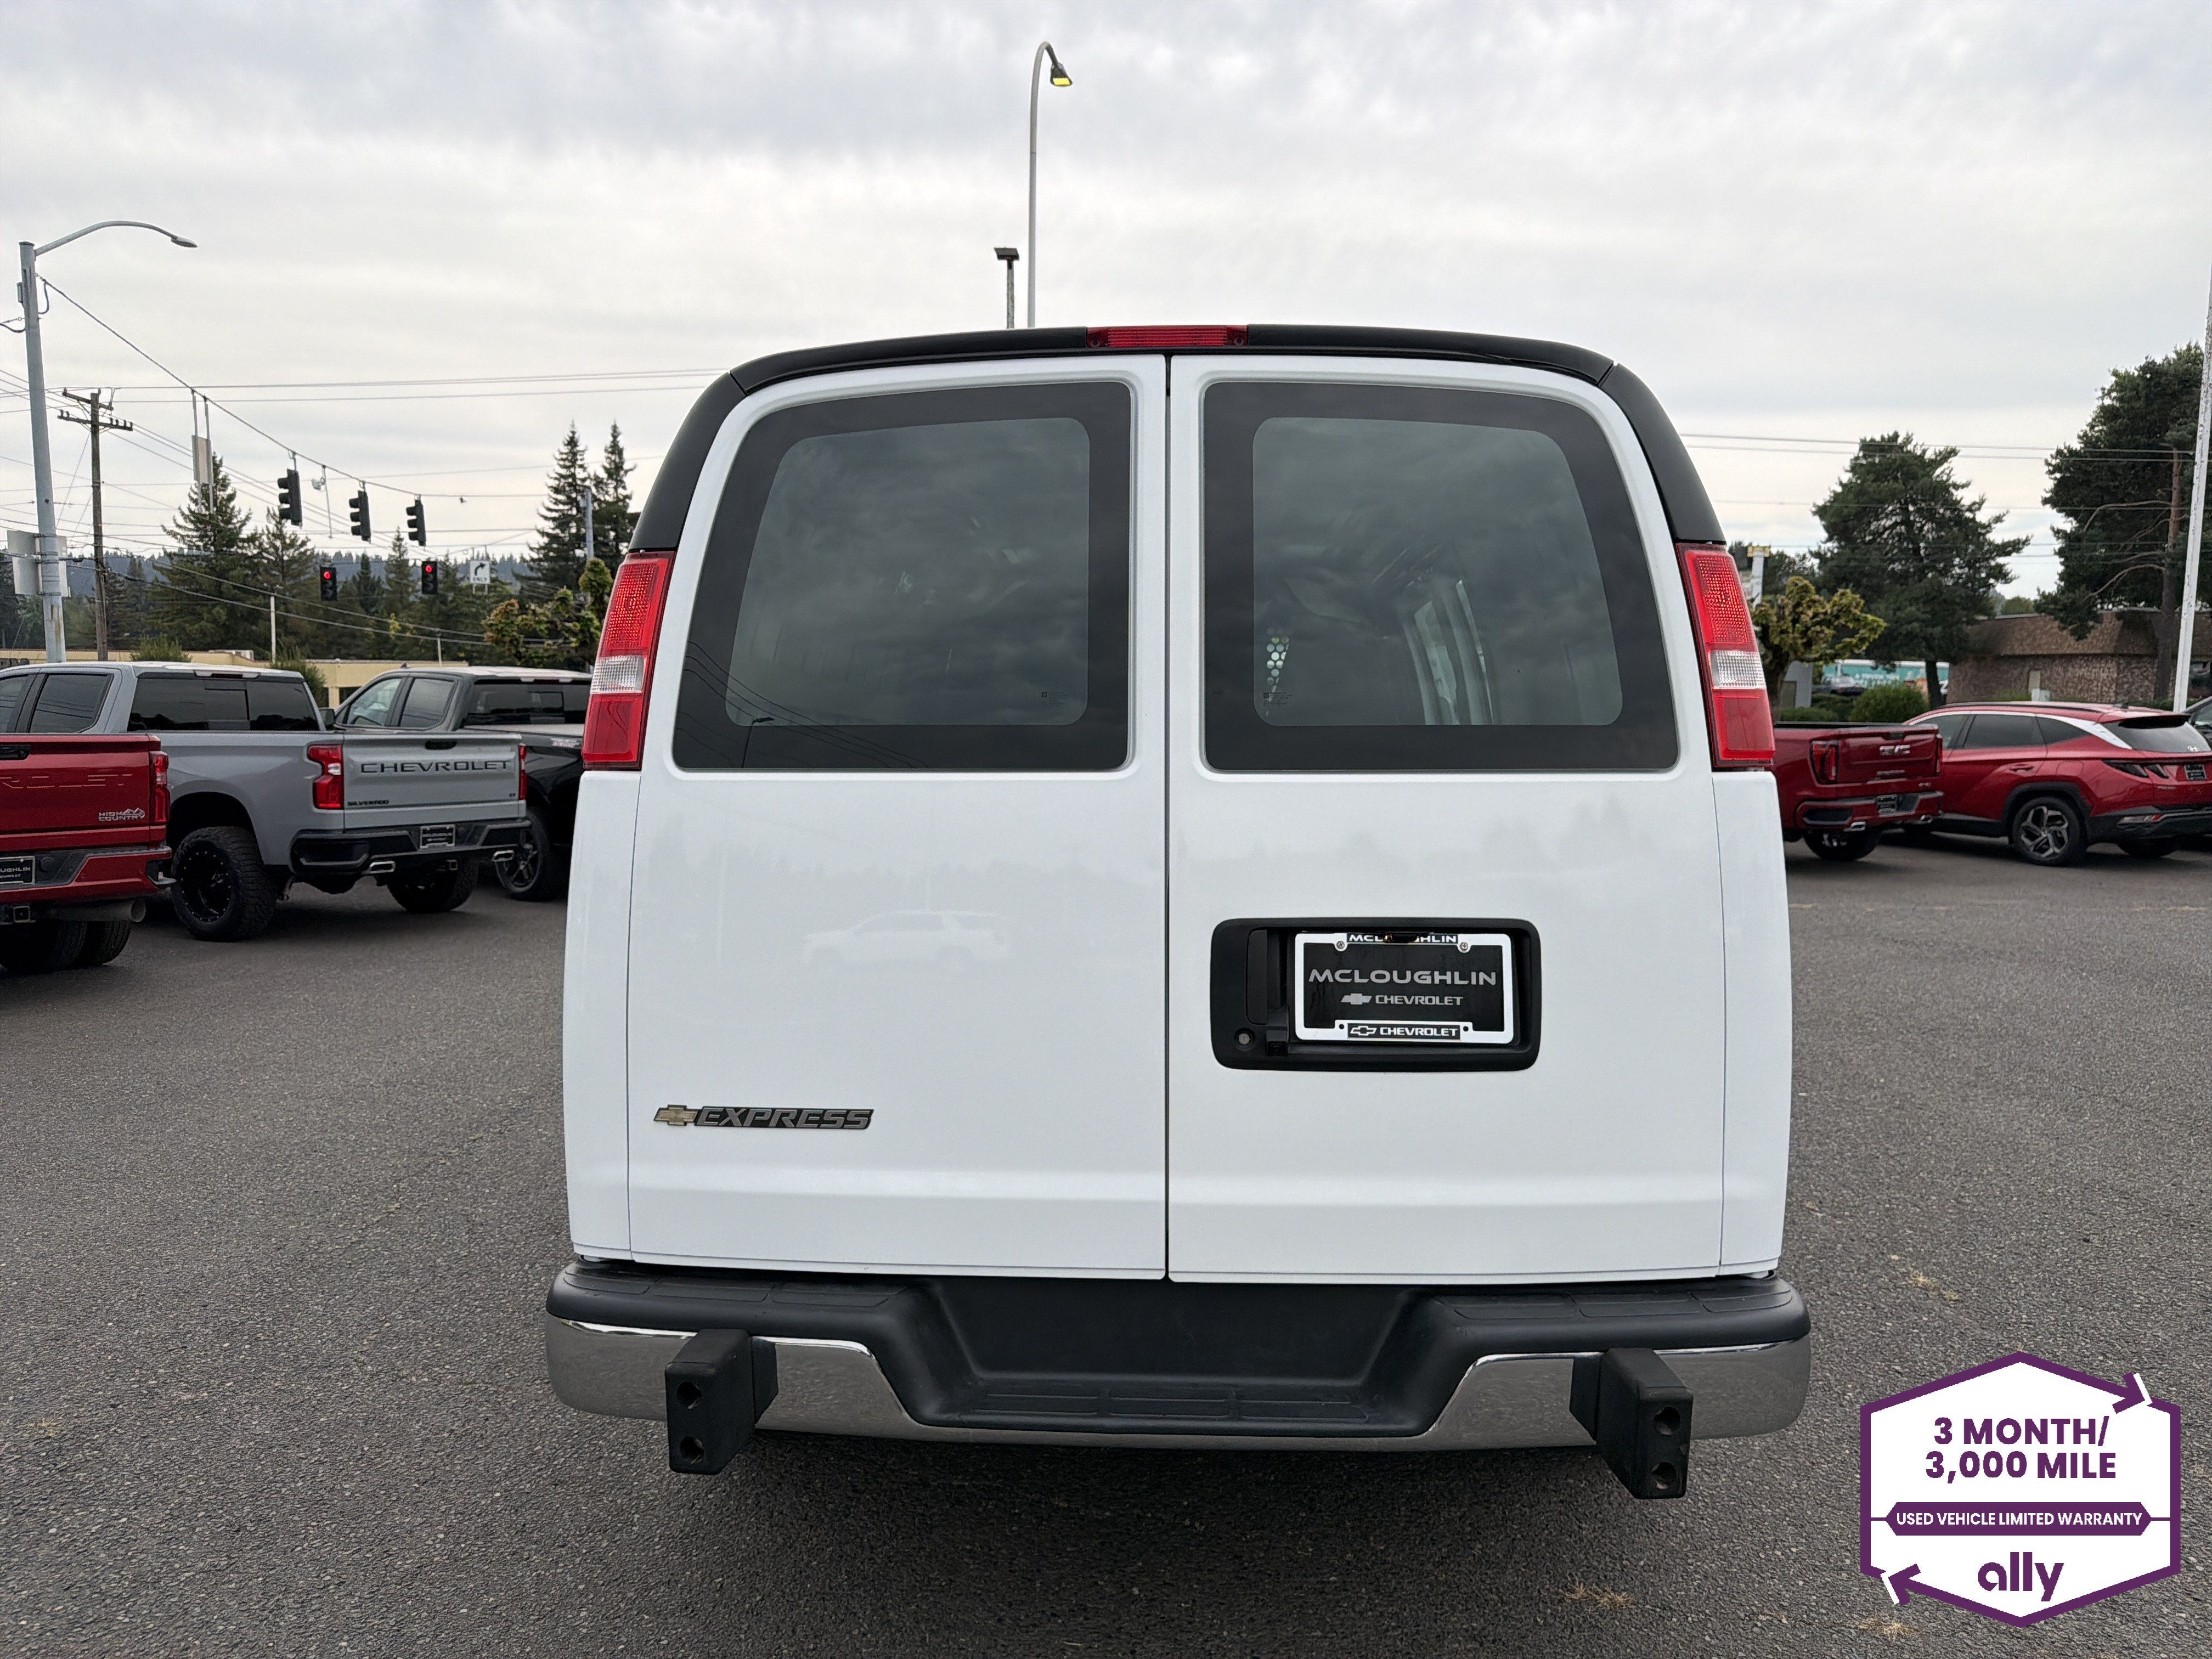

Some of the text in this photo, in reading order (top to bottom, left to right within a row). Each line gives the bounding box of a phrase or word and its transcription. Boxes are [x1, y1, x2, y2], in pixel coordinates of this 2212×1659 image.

[361, 760, 511, 773] CHEVROLET
[1349, 934, 1457, 943] MCLHLIN
[1308, 968, 1497, 986] MCLOUGHLIN
[1375, 995, 1464, 1006] CHEVROLET
[1380, 1026, 1459, 1037] CHEVROLET
[698, 1107, 872, 1129] EXPRESS
